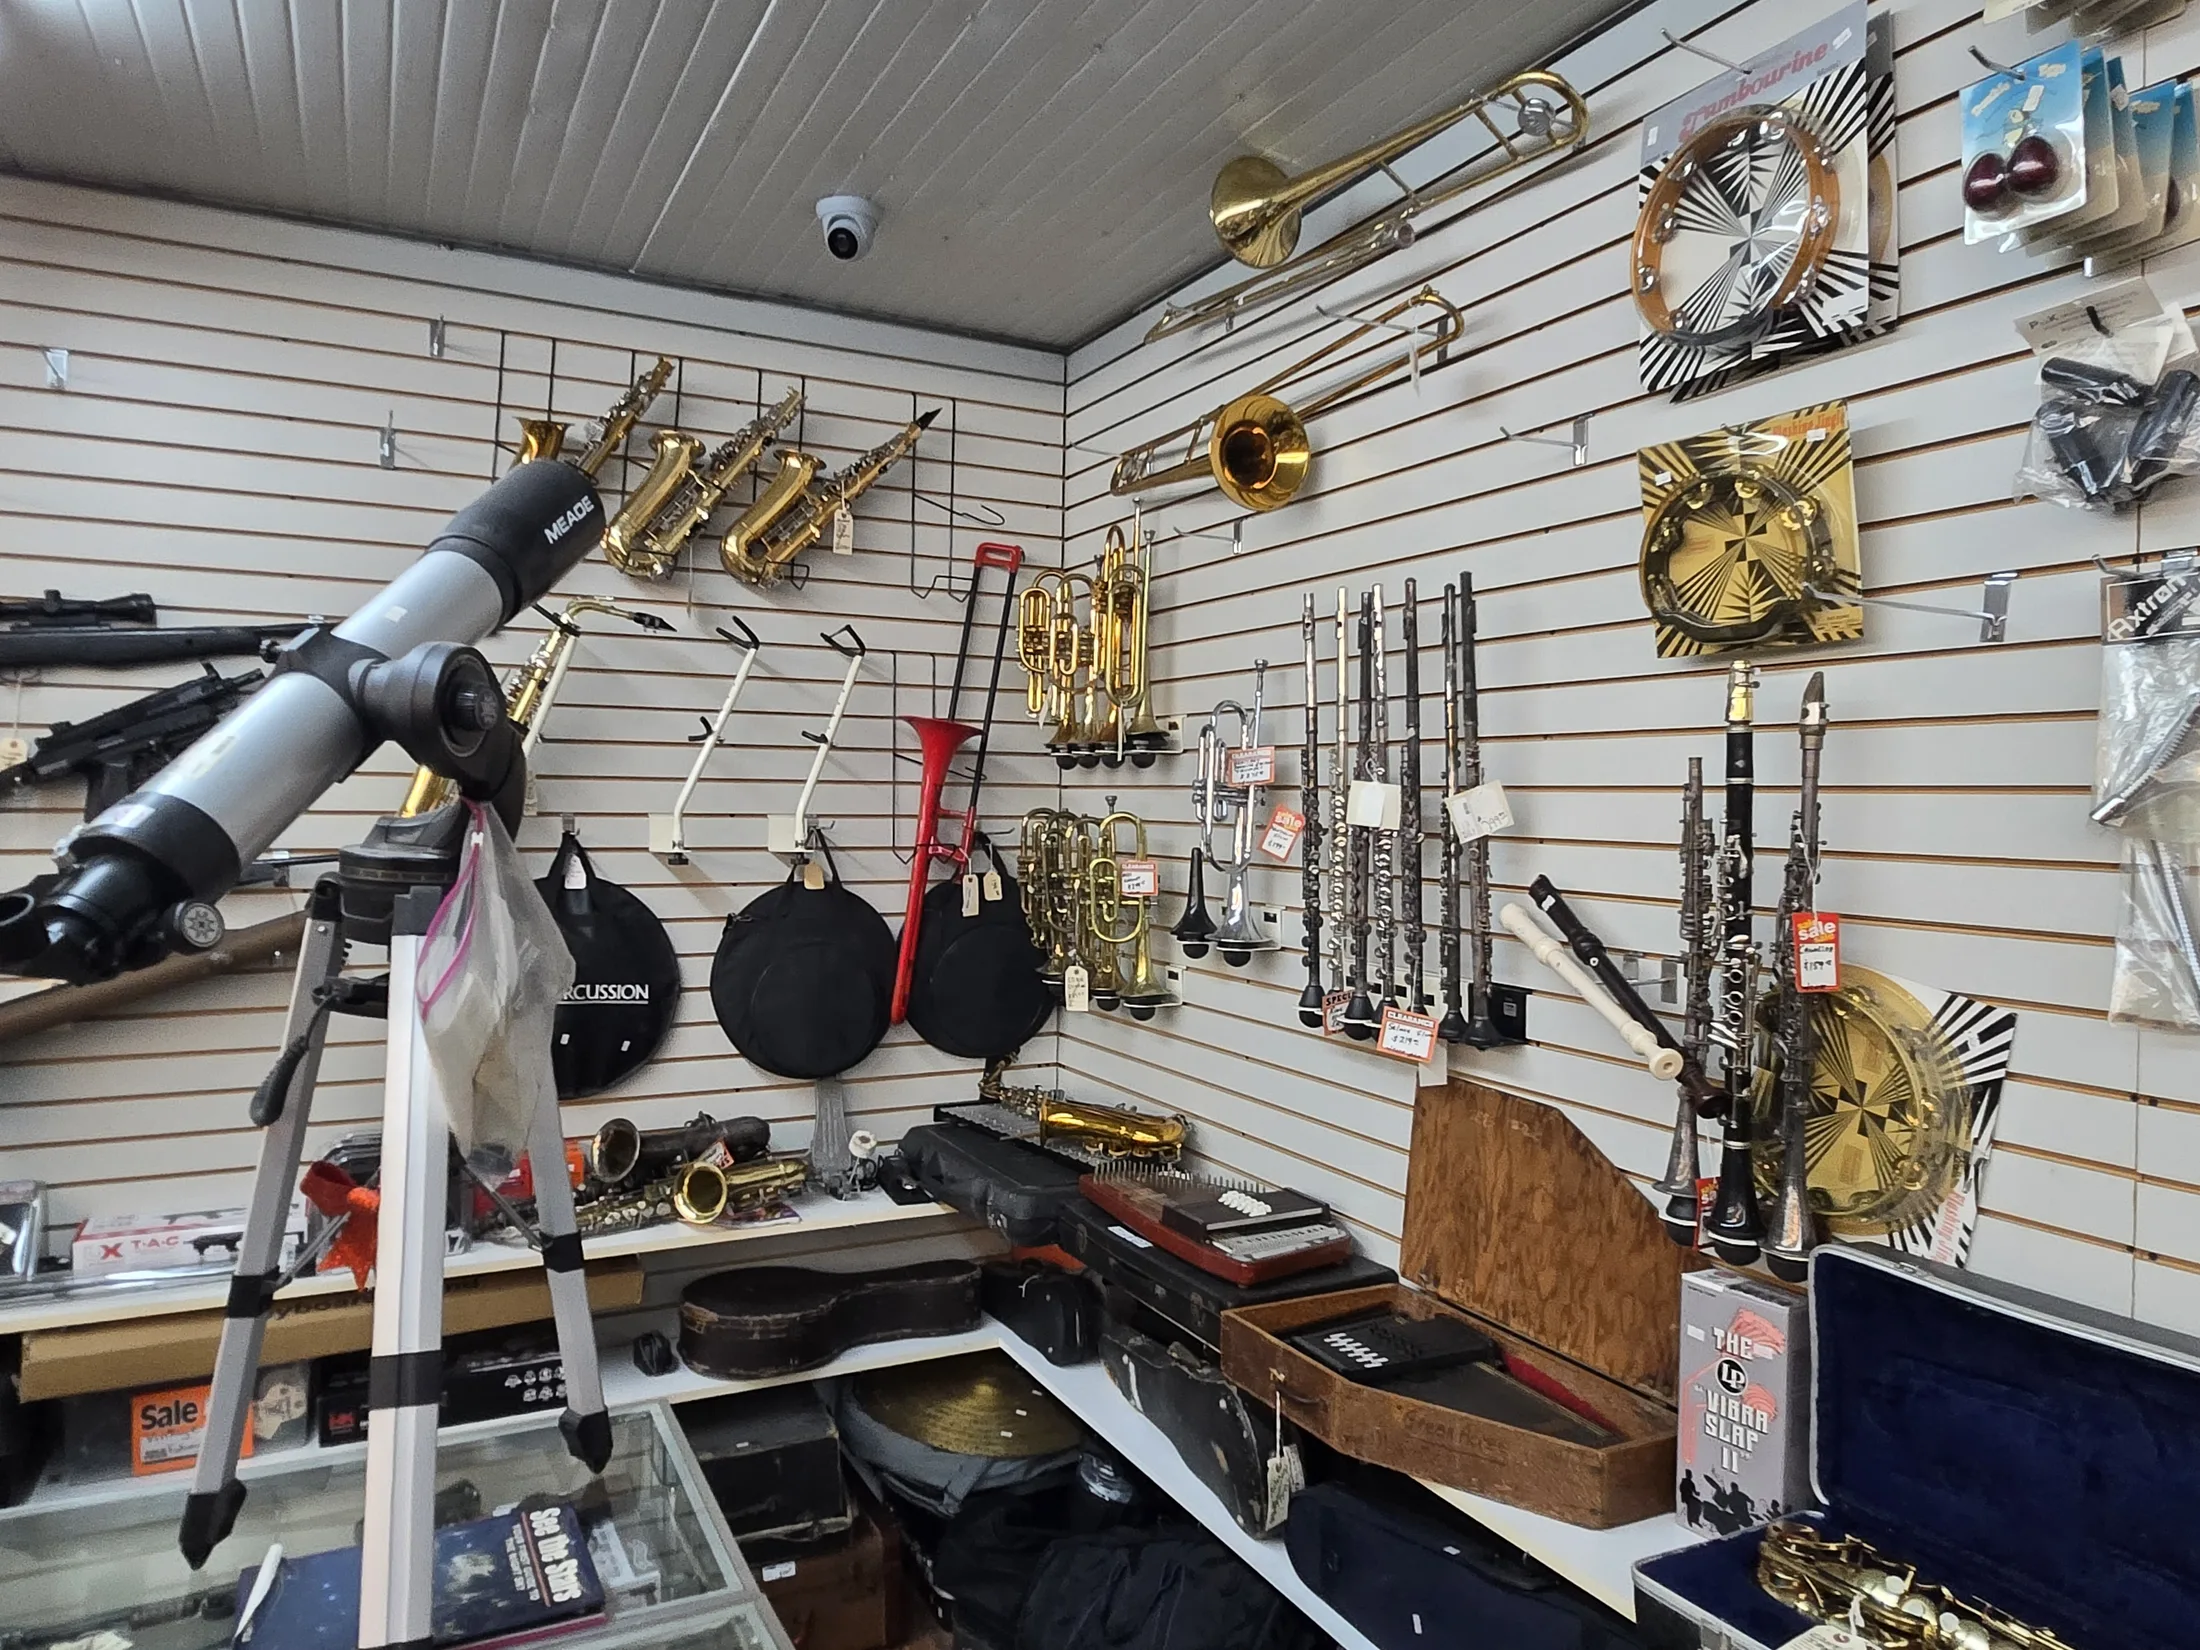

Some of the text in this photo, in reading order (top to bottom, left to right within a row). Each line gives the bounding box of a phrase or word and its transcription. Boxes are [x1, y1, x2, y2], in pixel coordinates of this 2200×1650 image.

[543, 495, 595, 545] MEADE
[1798, 920, 1837, 941] sale
[562, 984, 650, 1000] RCUSSION
[1325, 992, 1353, 1007] SPECI
[1712, 1326, 1754, 1361] THE
[141, 1400, 198, 1430] Sale
[1704, 1411, 1759, 1453] SLAP
[530, 1507, 582, 1603] See the Stars
